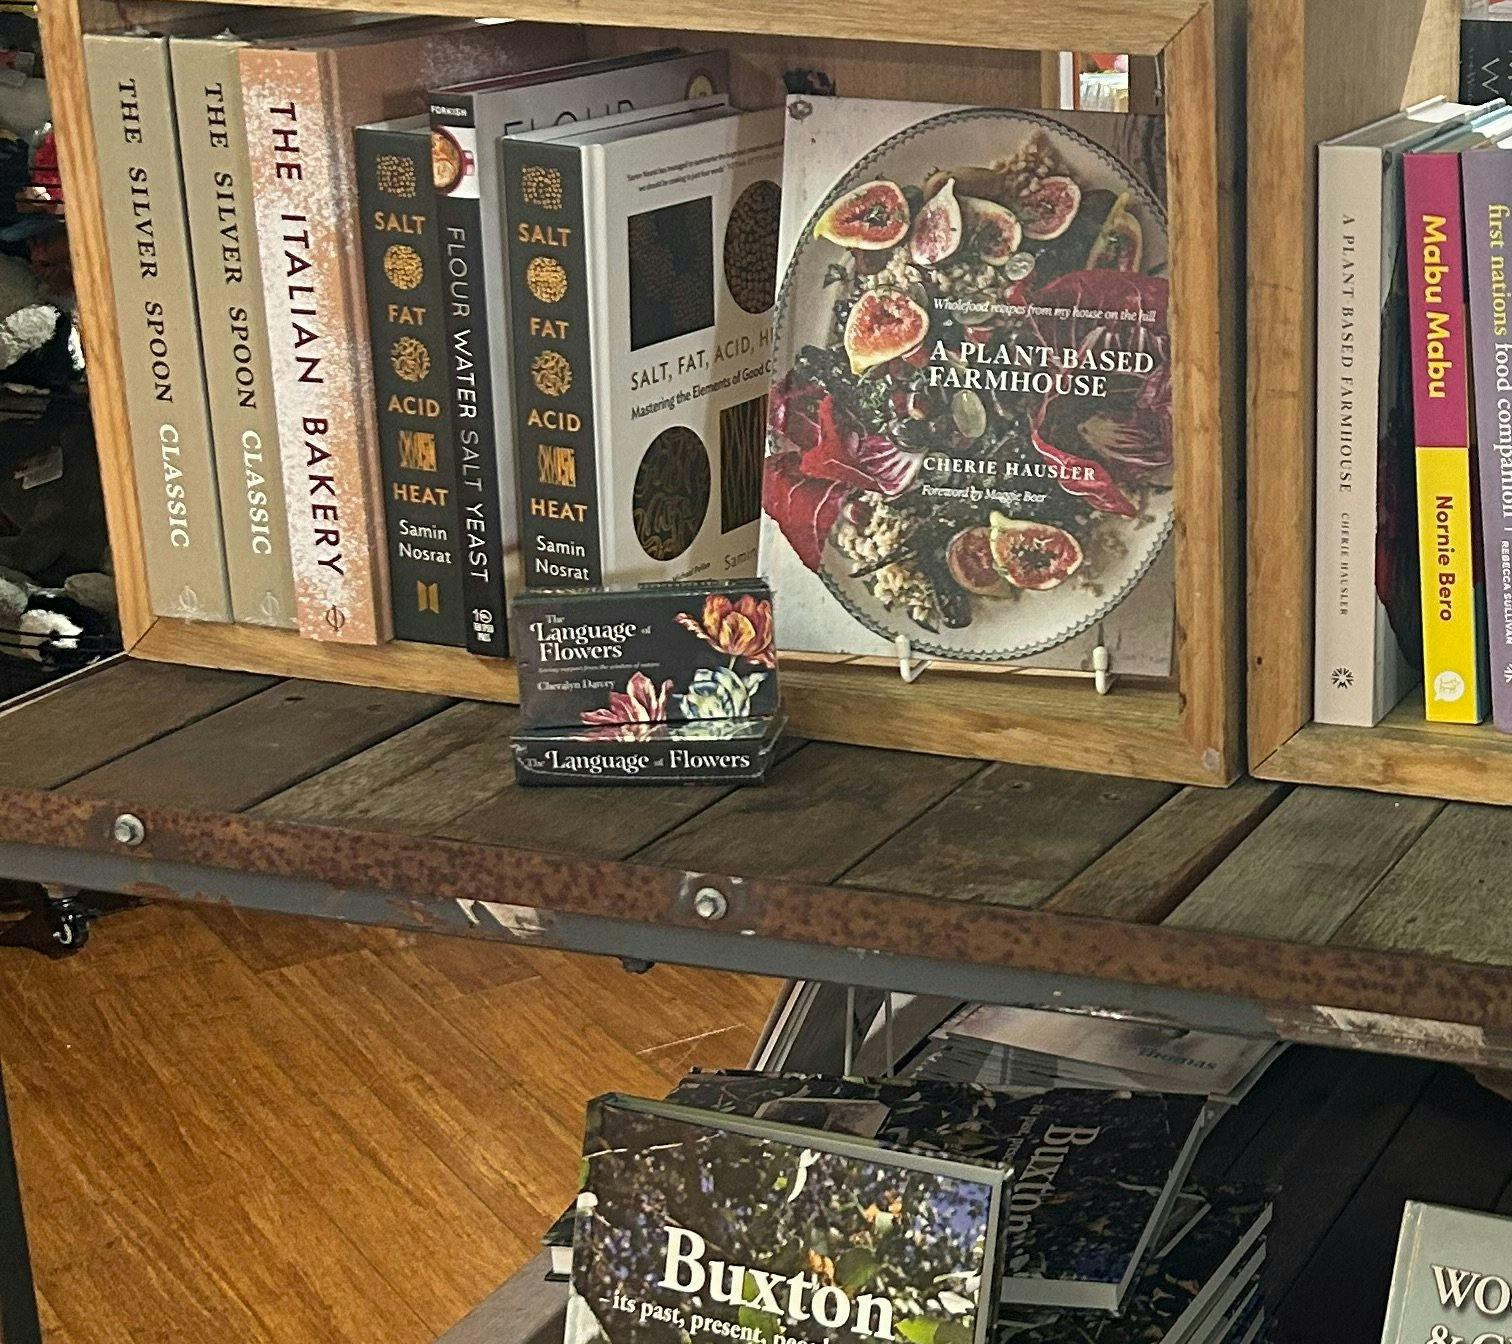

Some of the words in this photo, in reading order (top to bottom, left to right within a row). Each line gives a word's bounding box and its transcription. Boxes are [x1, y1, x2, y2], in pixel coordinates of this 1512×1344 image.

[118, 77, 142, 144] THE
[269, 102, 302, 181] THE
[128, 166, 157, 279] SILVER
[374, 211, 426, 235] SALT
[1488, 204, 1511, 250] first
[446, 226, 470, 317] FLOUR
[1423, 214, 1449, 304] Mabu
[281, 214, 323, 384] ITALIAN
[388, 304, 426, 326] FAT
[933, 298, 989, 313] Wholefood
[1104, 311, 1118, 320] on
[1120, 309, 1137, 321] the
[1490, 256, 1512, 337] nations
[145, 301, 173, 403] SPOON
[453, 329, 477, 419] WATER
[630, 361, 673, 391] SALT,
[678, 350, 709, 375] FAT,
[713, 336, 755, 362] ACID,
[930, 340, 949, 361] A
[1426, 312, 1452, 399] Mabu
[388, 394, 441, 418] ACID
[631, 397, 675, 421] Mastering
[676, 389, 691, 404] the
[692, 377, 731, 399] Elements
[732, 371, 742, 388] of
[928, 367, 1108, 398] FARMHOUSE
[159, 423, 189, 549] CLASSIC
[460, 430, 483, 492] SALT
[923, 457, 998, 475] CHERIE
[1005, 460, 1096, 481] HAUSLER
[302, 416, 345, 576] BAKERY
[393, 482, 449, 506] HEAT
[921, 485, 969, 499] Foreword
[970, 487, 983, 501] by
[985, 488, 1022, 504] Maggie
[399, 542, 452, 564] Nosrat
[400, 519, 448, 540] Samin
[465, 503, 489, 583] YEAST
[1435, 495, 1456, 567] Nornie
[545, 615, 565, 624] The
[1439, 572, 1456, 622] Bero
[530, 622, 637, 644] Language
[539, 642, 623, 662] Flowers
[545, 749, 650, 774] Language
[669, 749, 751, 769] Flowers
[1008, 1123, 1101, 1232] Buxton
[658, 1225, 896, 1341] Buxton
[612, 1290, 637, 1313] its
[639, 1304, 685, 1329] past,
